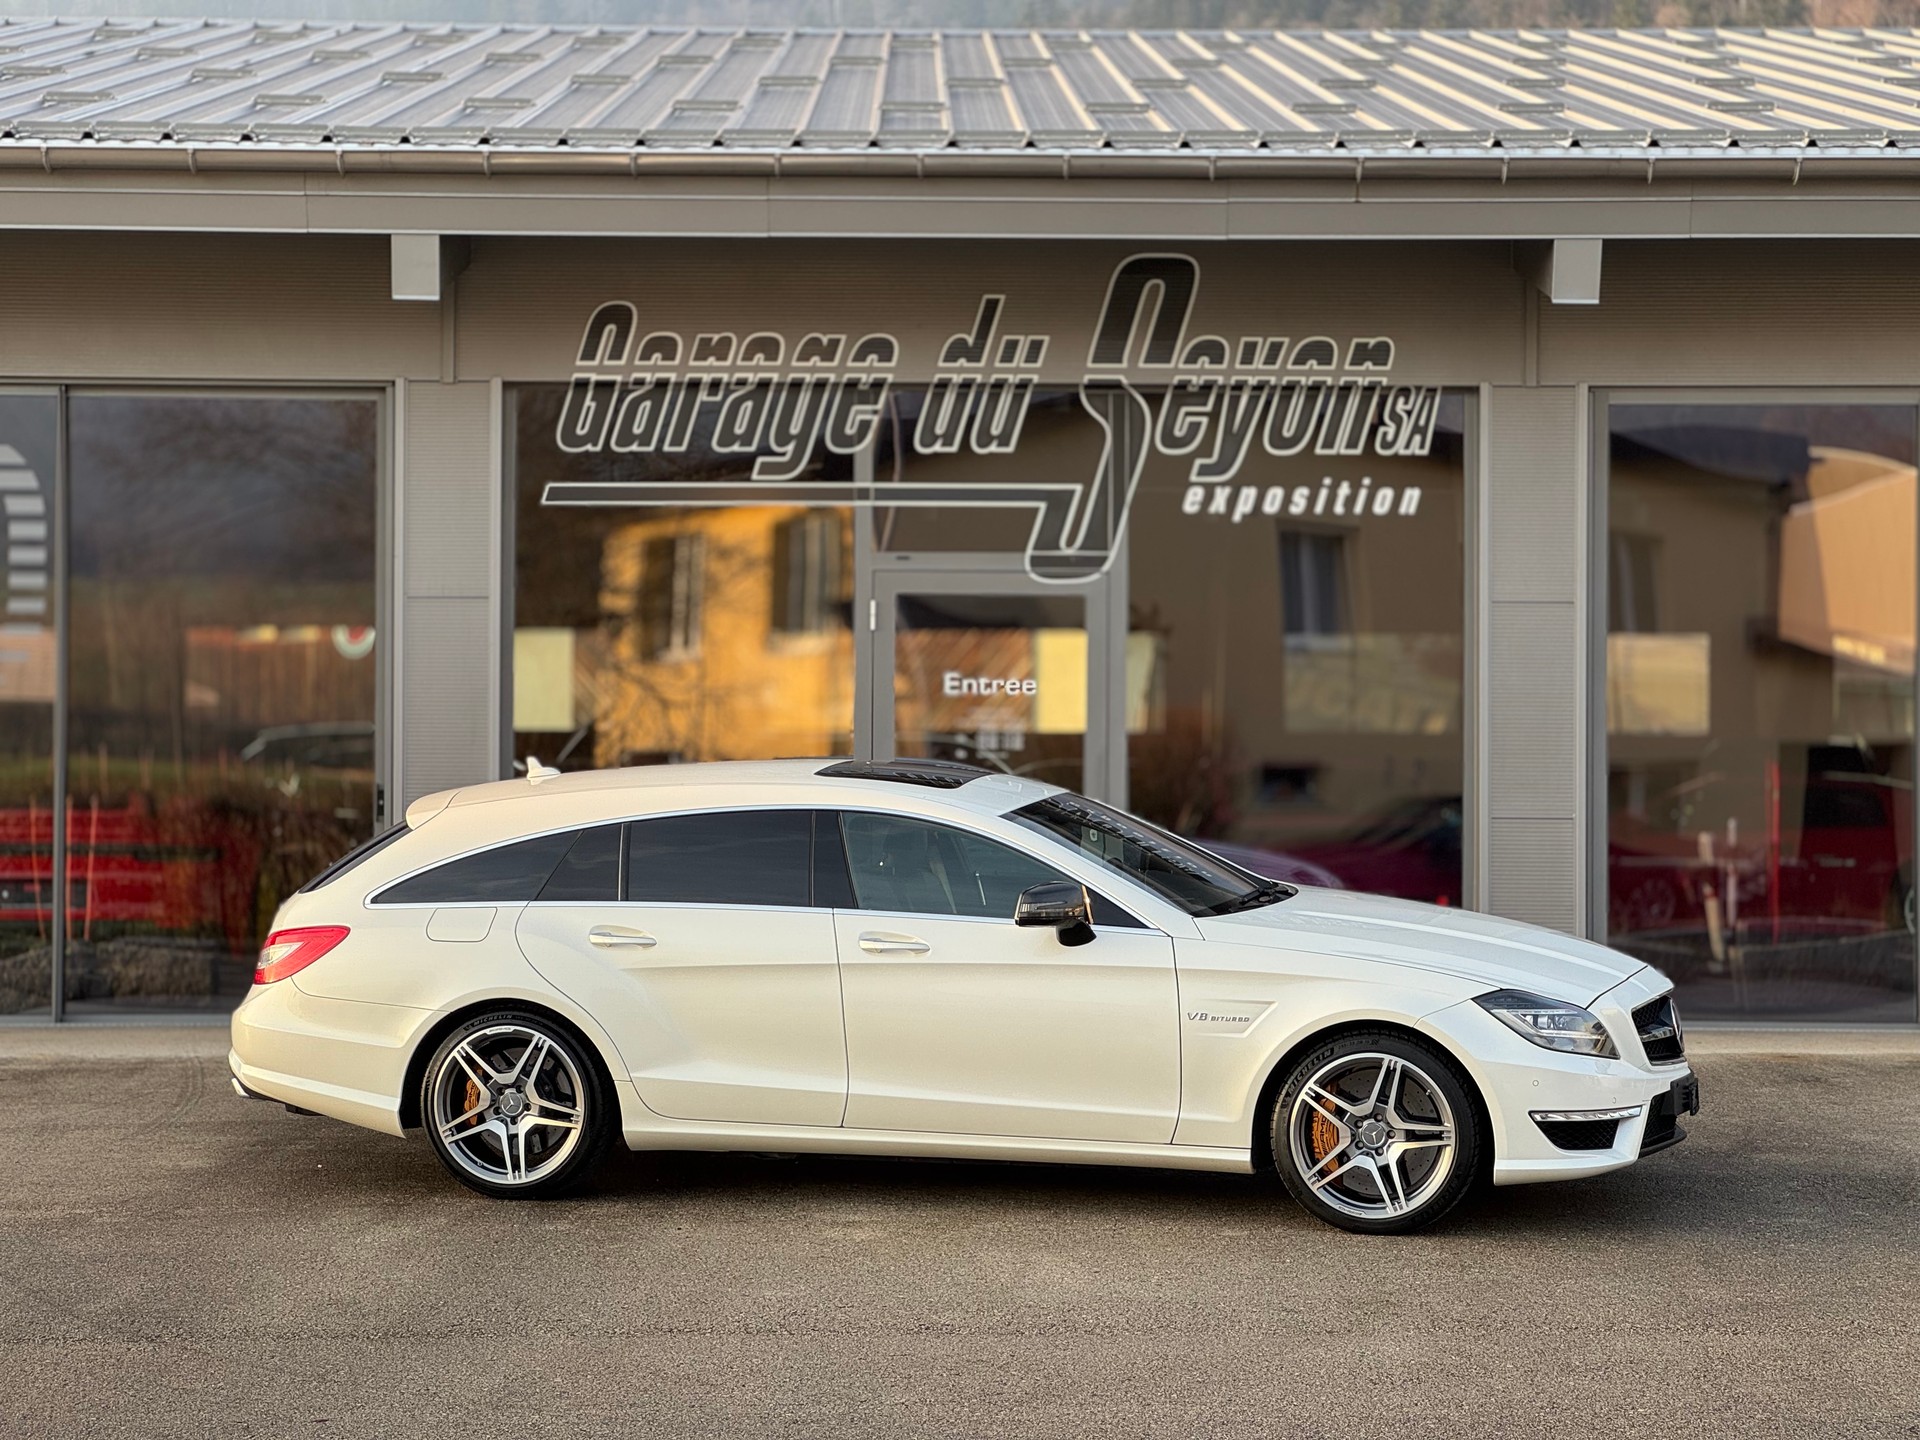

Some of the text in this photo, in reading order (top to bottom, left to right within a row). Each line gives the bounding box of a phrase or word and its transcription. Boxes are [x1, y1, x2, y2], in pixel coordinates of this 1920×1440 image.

[556, 252, 1442, 584] Garage du Seyon SA
[1182, 477, 1422, 523] exposition
[943, 671, 1037, 696] Entree
[473, 1014, 513, 1027] MICHELIN
[1187, 1012, 1208, 1021] V8
[1287, 1048, 1332, 1096] MICHELIN
